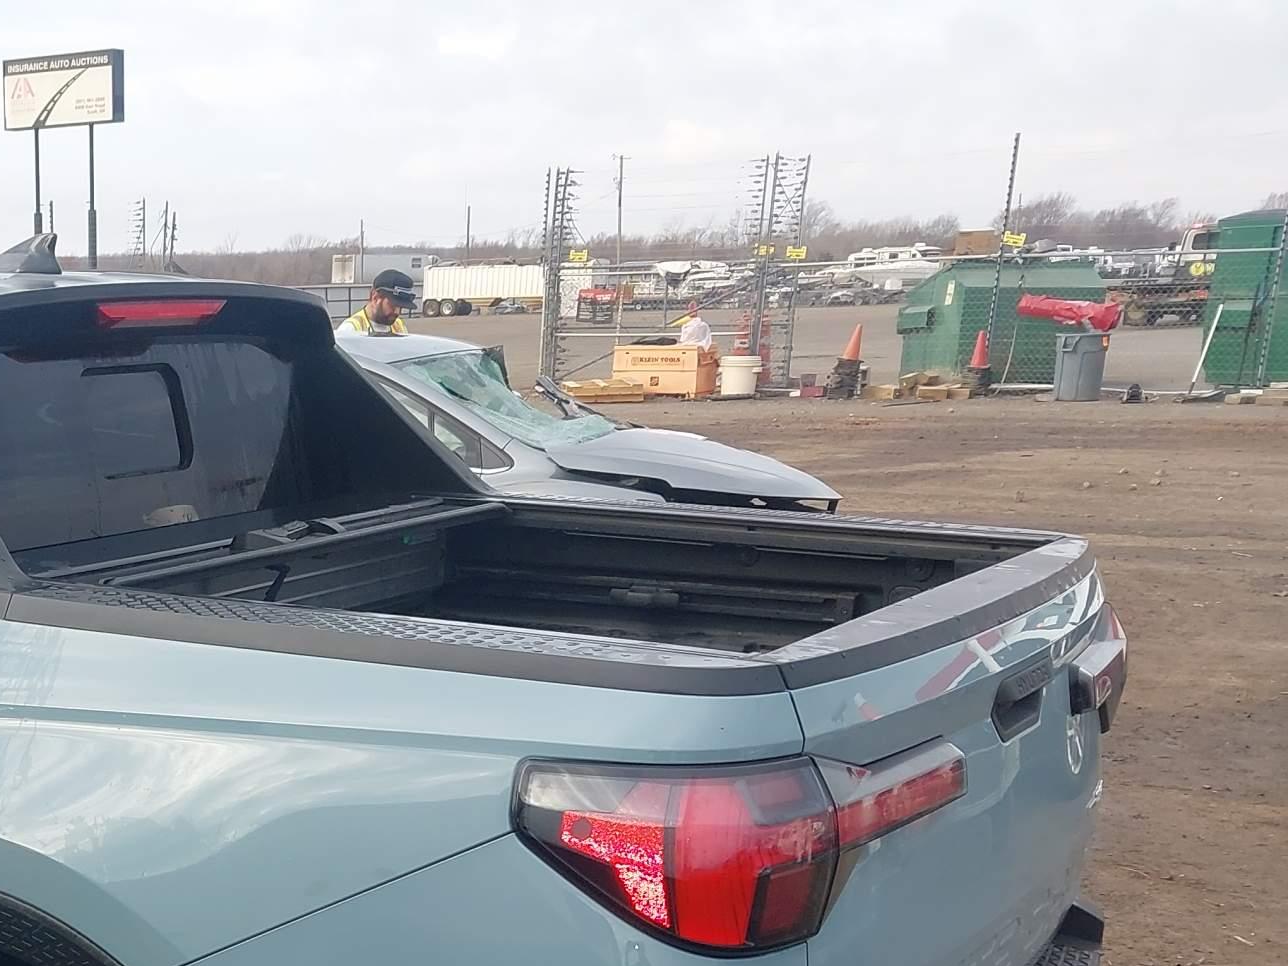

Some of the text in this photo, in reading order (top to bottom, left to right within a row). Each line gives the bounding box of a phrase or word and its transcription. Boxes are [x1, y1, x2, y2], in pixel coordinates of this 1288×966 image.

[7, 55, 109, 73] INSURANCE AUTO AUCTIONS
